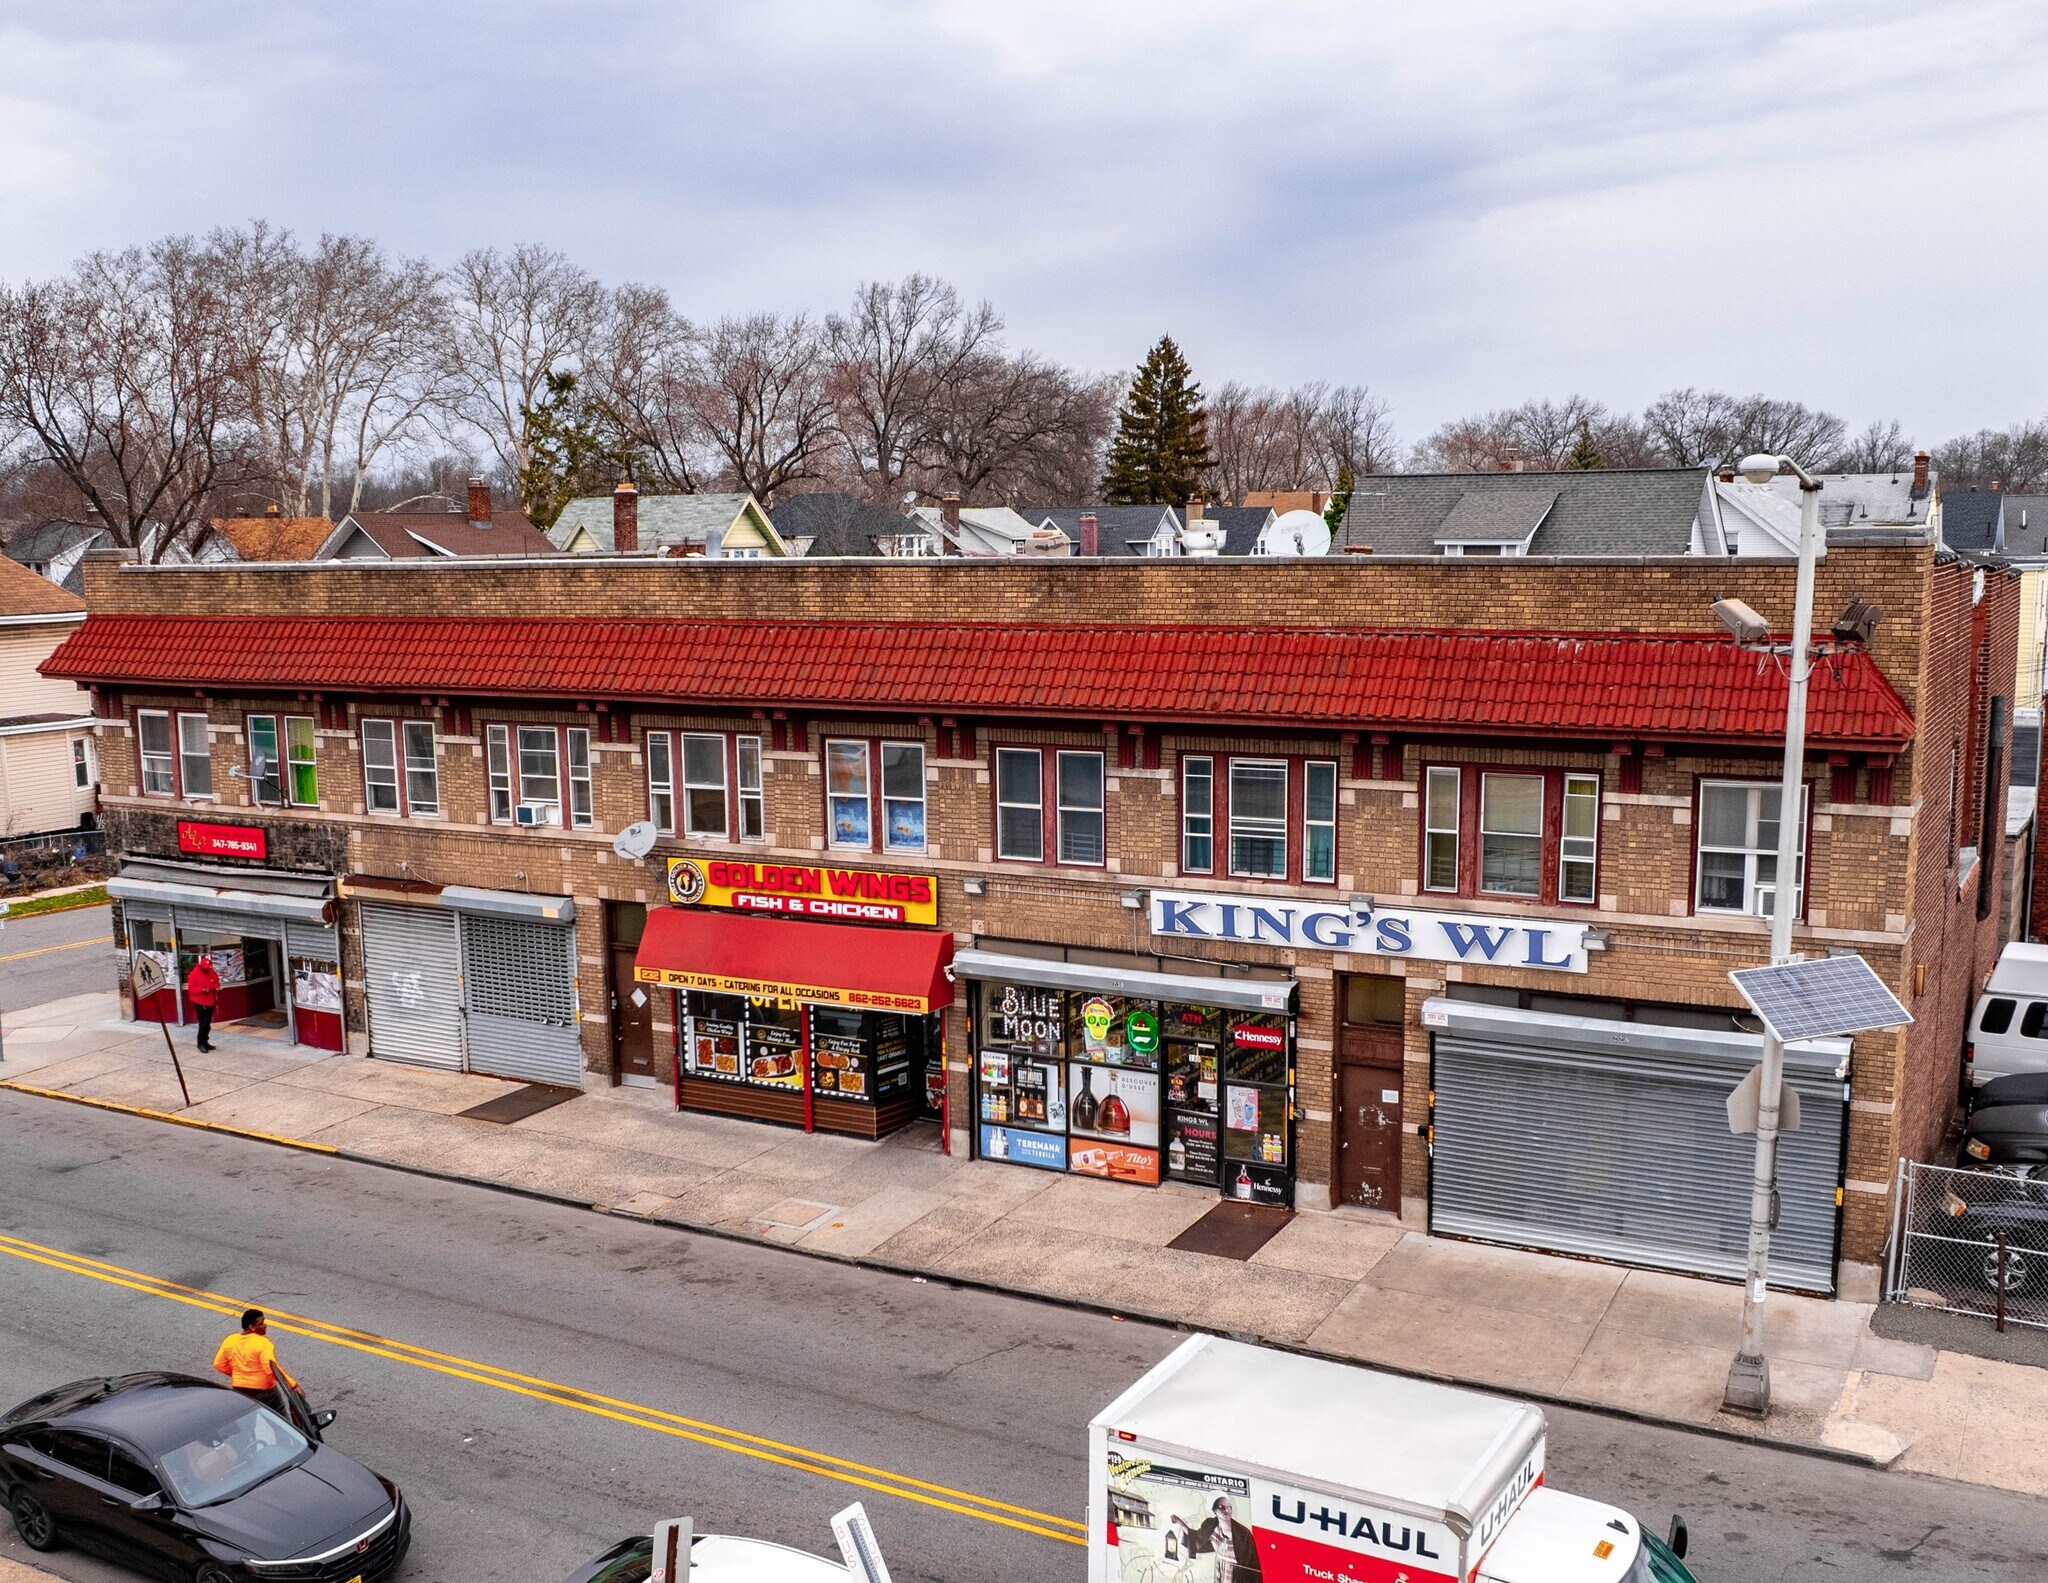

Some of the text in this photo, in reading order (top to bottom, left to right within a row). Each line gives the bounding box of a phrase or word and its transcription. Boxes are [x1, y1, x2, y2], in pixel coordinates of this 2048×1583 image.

[212, 838, 257, 851] 347-785-9341
[708, 862, 931, 903] GOLDEN WINGS
[738, 894, 898, 919] FISH & CHICKEN
[1156, 898, 1572, 968] KING'S WL
[641, 970, 921, 1009] 232 OPEN 7 DAYS CATERING FOR ALL OCCASIONS 862-252-6623
[1002, 986, 1060, 1018] BLUE
[1181, 1013, 1202, 1024] ATM
[1004, 1015, 1061, 1041] MOON
[1242, 1030, 1282, 1045] Hennessy
[1184, 1127, 1217, 1139] HOURS
[1017, 1138, 1061, 1152] TEREMANA
[1032, 1150, 1055, 1158] TEQUILA
[1126, 1152, 1153, 1165] Tito's
[1253, 1183, 1282, 1195] Hennessy
[1204, 1475, 1245, 1488] ONTARIO
[1481, 1460, 1535, 1547] U-HAUL
[1272, 1494, 1439, 1560] U-HAUL
[1303, 1563, 1335, 1582] Truck
